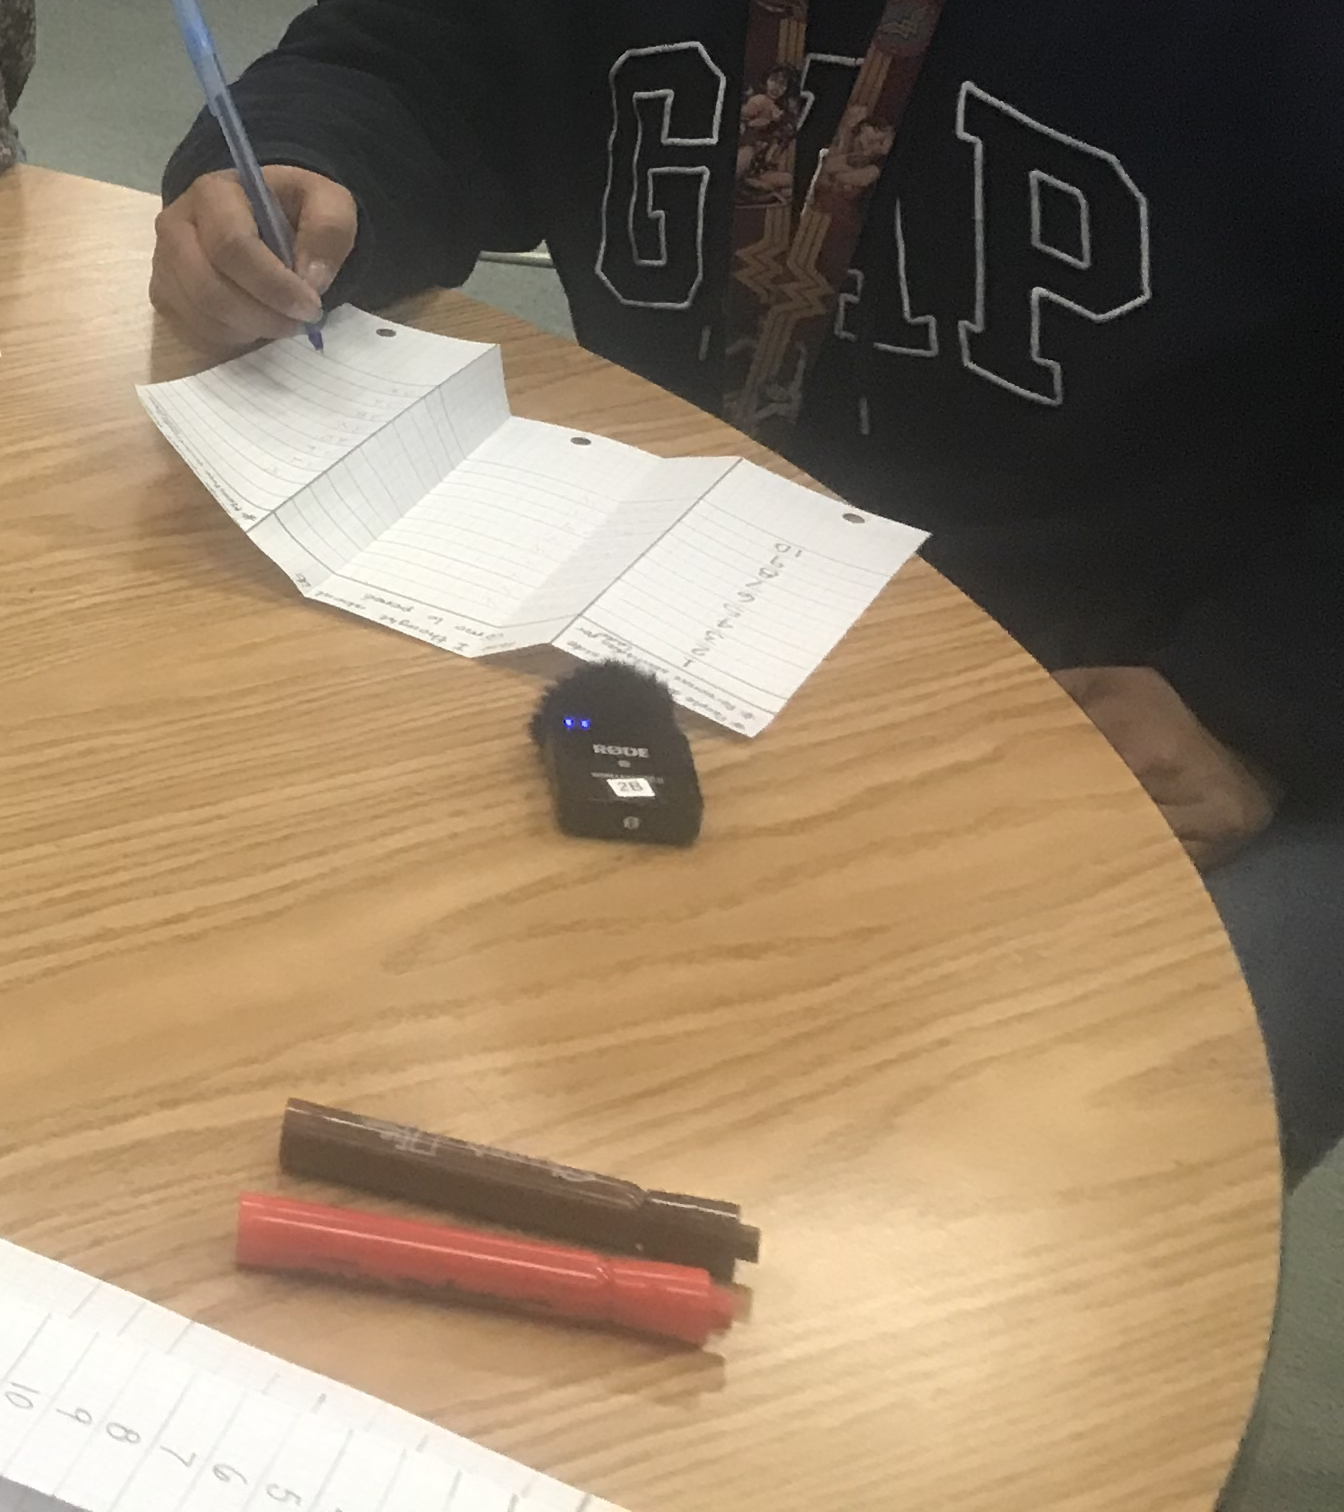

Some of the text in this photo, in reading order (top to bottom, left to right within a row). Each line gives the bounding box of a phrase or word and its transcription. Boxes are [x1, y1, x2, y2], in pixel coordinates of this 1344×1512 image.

[774, 541, 803, 558] 10
[691, 646, 711, 657] 2
[4, 1381, 40, 1410] 10
[55, 1407, 93, 1425] 9
[105, 1421, 142, 1445] 8
[160, 1445, 197, 1468] 7
[211, 1463, 249, 1486] 6
[265, 1482, 302, 1506] 5
